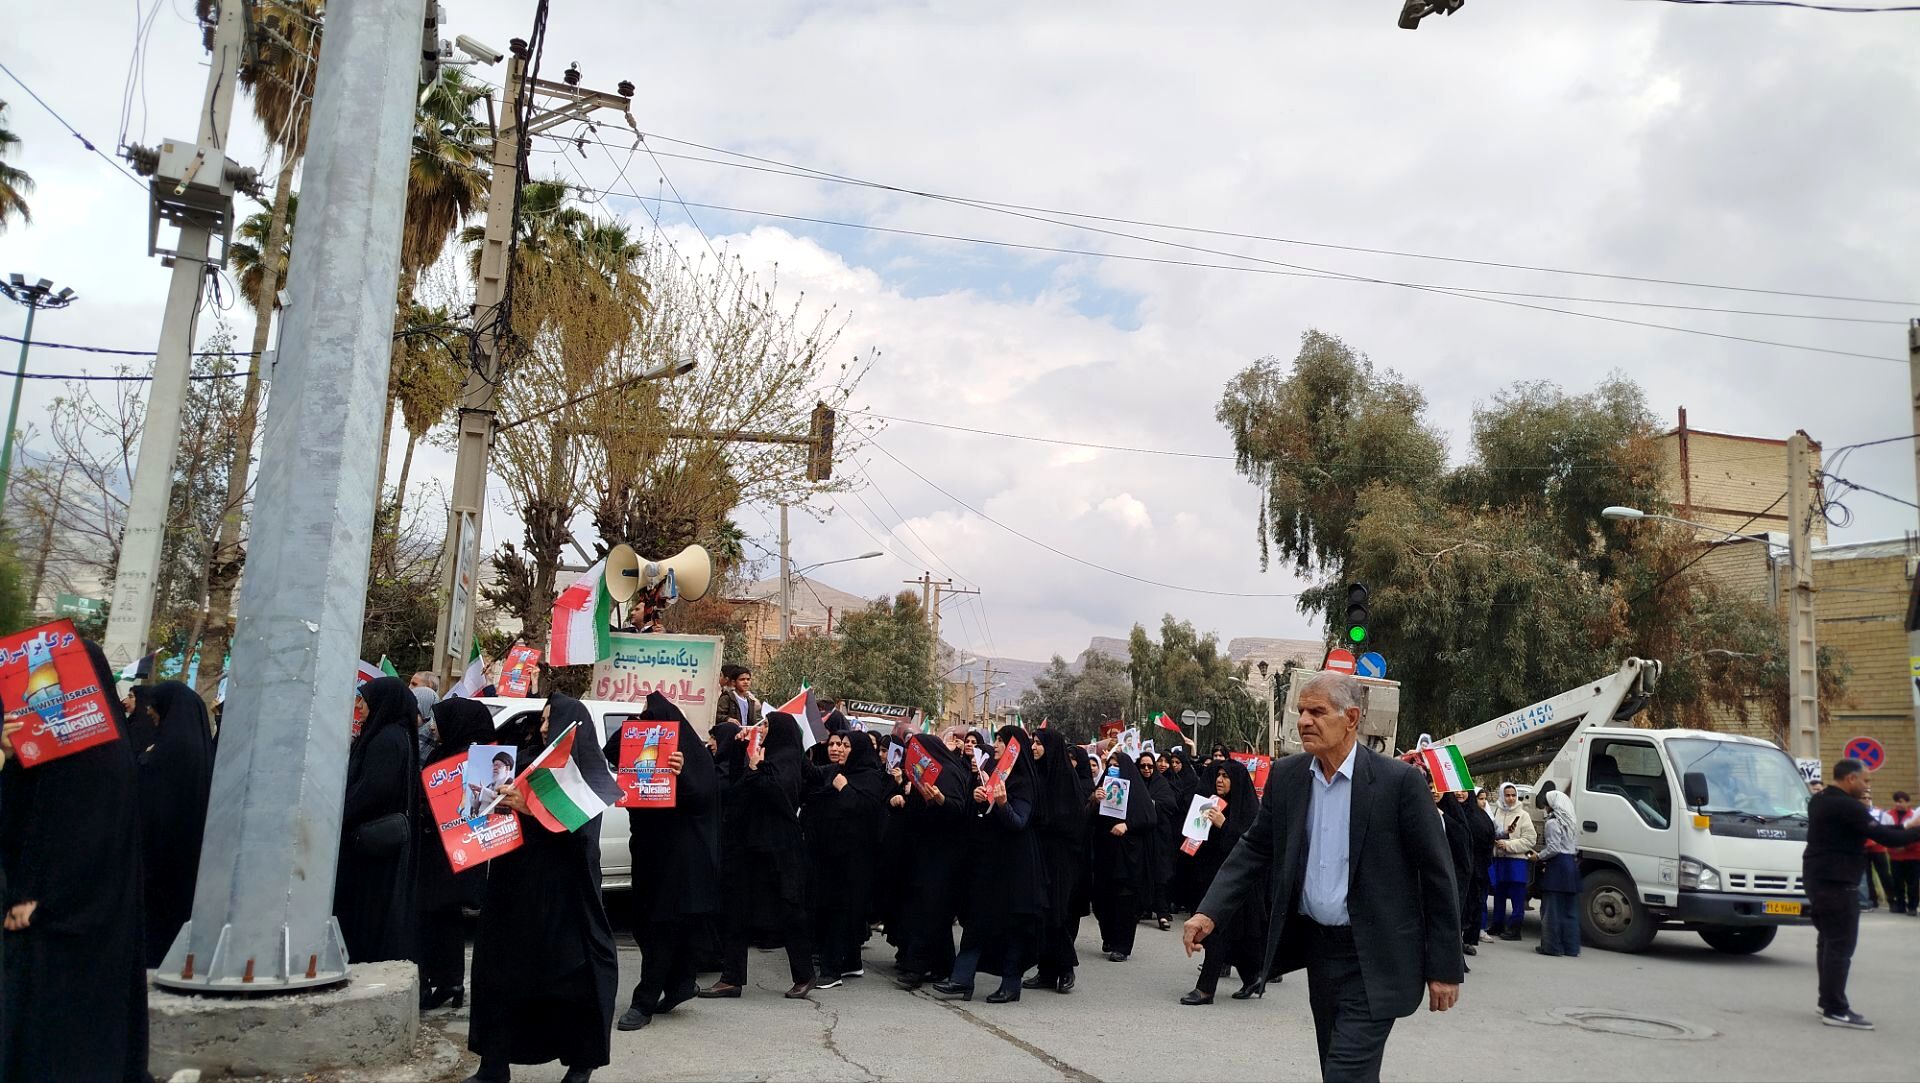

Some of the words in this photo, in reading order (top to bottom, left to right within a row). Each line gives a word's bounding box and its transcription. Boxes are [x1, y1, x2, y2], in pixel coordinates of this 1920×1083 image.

[613, 651, 637, 670] بسیج
[637, 649, 671, 667] مقاومت
[671, 648, 698, 678] پایگاه
[37, 695, 62, 709] WITH
[64, 686, 99, 702] ISRAEL
[656, 679, 705, 702] علامه
[50, 711, 106, 738] Palestine
[441, 816, 467, 832] DOWN
[477, 821, 518, 845] Palestine
[1757, 829, 1787, 838] ISUZU
